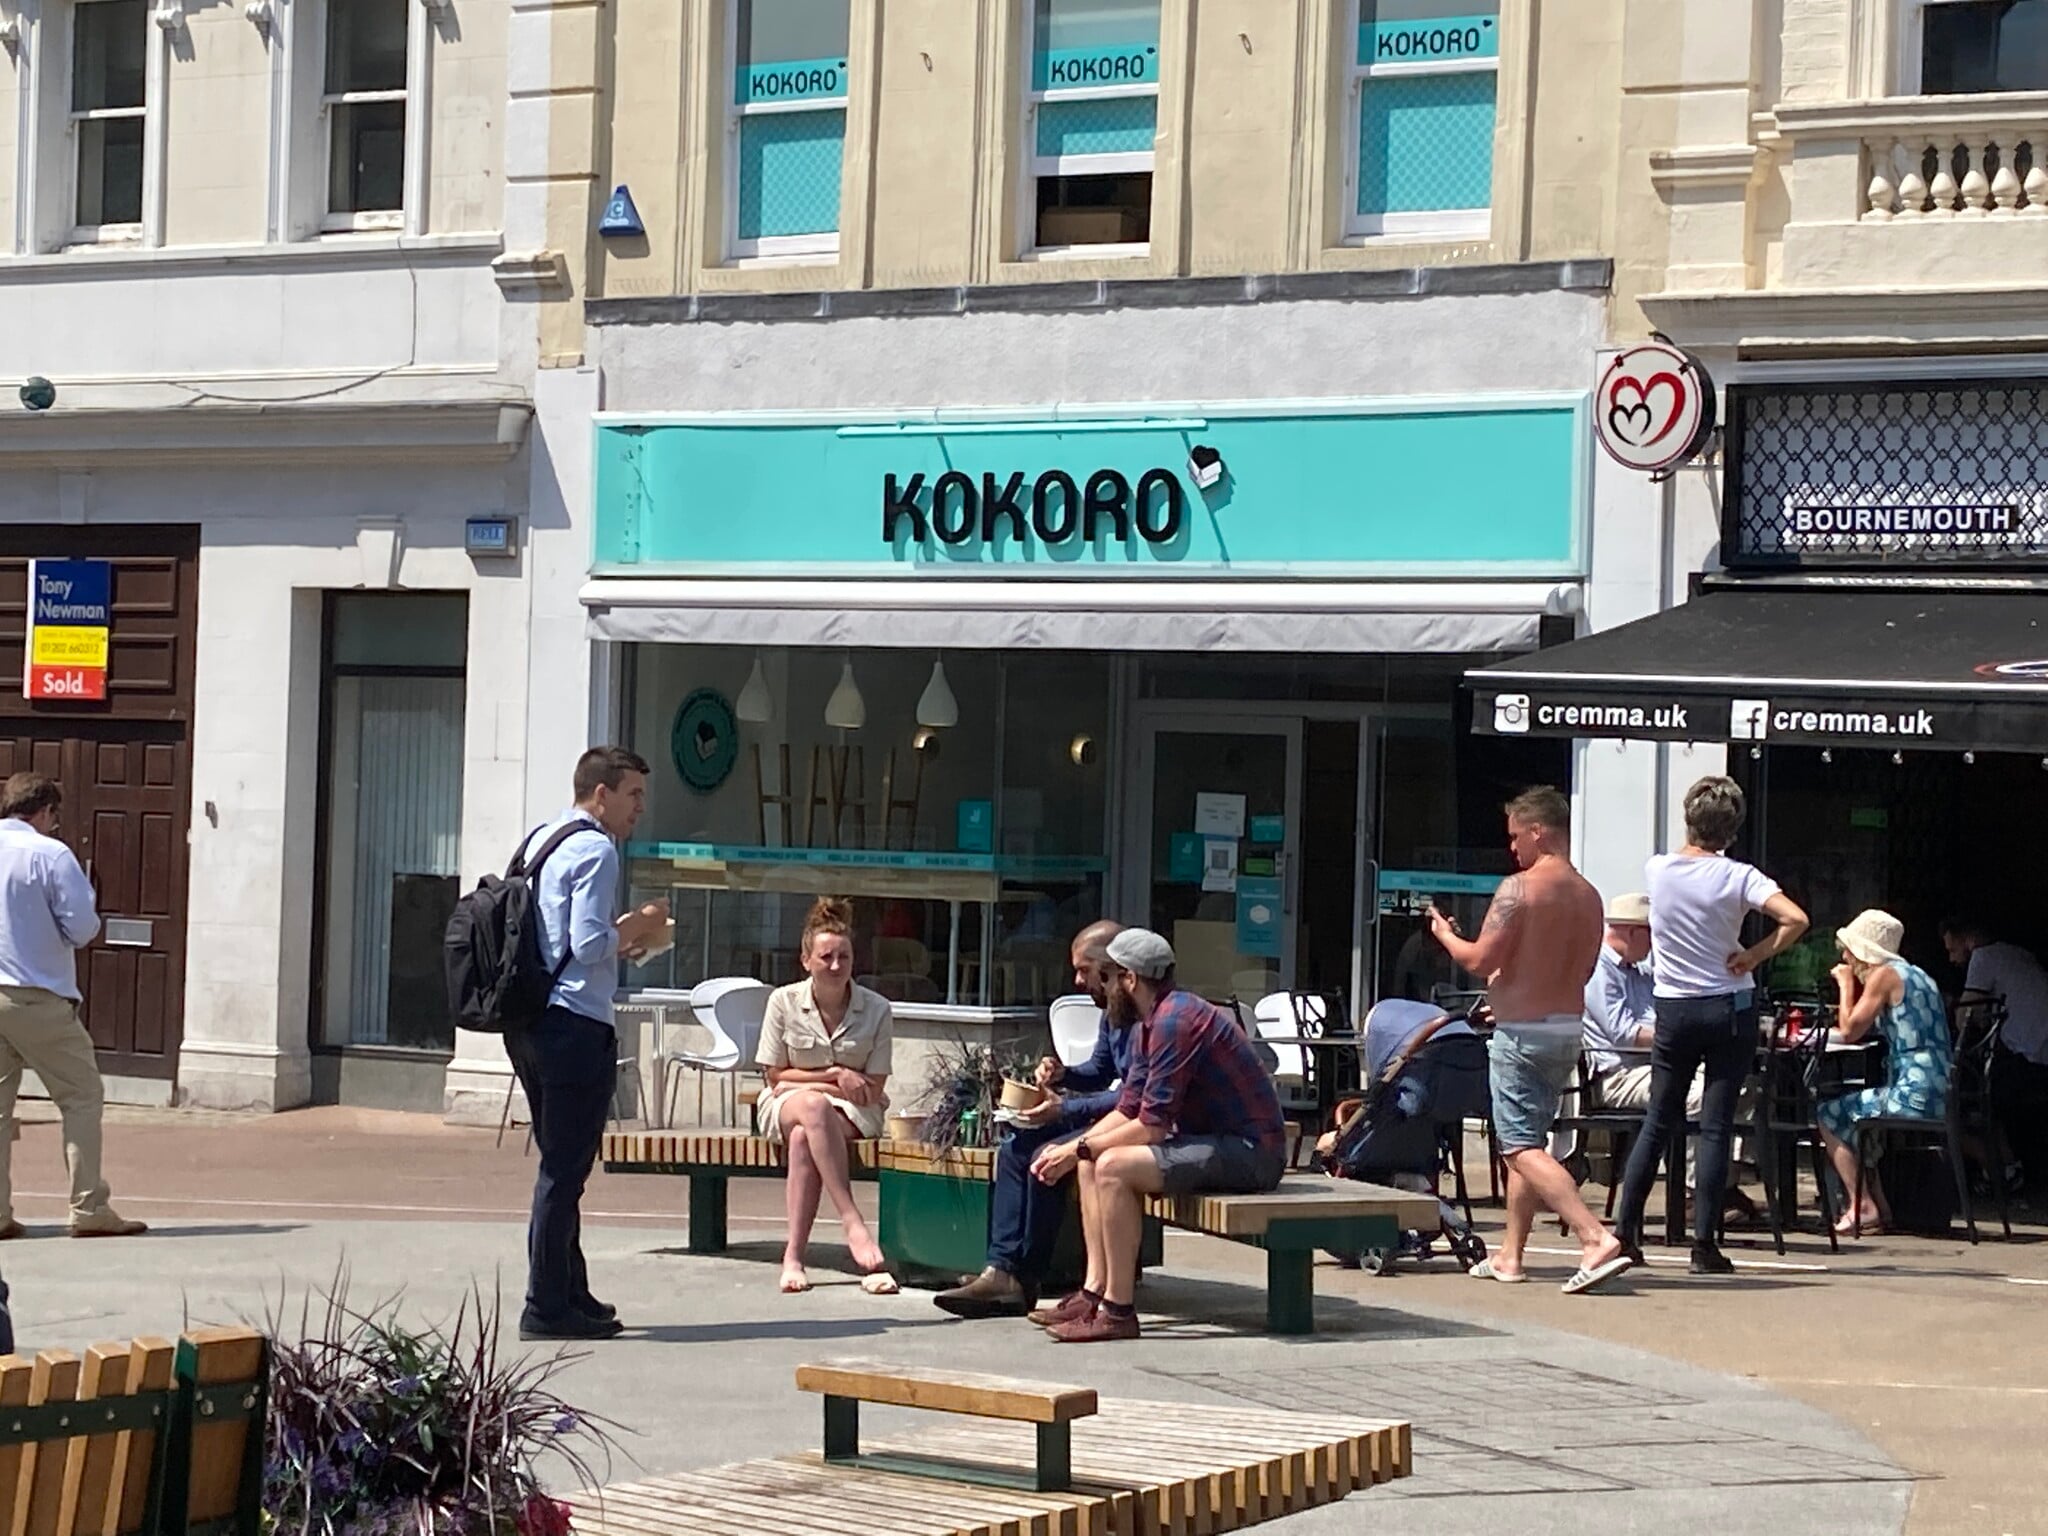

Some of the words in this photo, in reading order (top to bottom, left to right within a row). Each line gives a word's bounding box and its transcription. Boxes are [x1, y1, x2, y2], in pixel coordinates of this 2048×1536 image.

[1378, 28, 1480, 57] KOKORO
[752, 68, 837, 97] KOKORO
[1051, 55, 1144, 83] KOKORO
[883, 468, 1182, 543] KOKORO
[1796, 508, 2010, 531] BOURNEMOUTH
[38, 574, 74, 601] Tony
[38, 598, 105, 619] Newman
[43, 670, 84, 694] Sold
[1537, 703, 1689, 729] cremma.uk
[1773, 708, 1934, 736] cremma.uk
